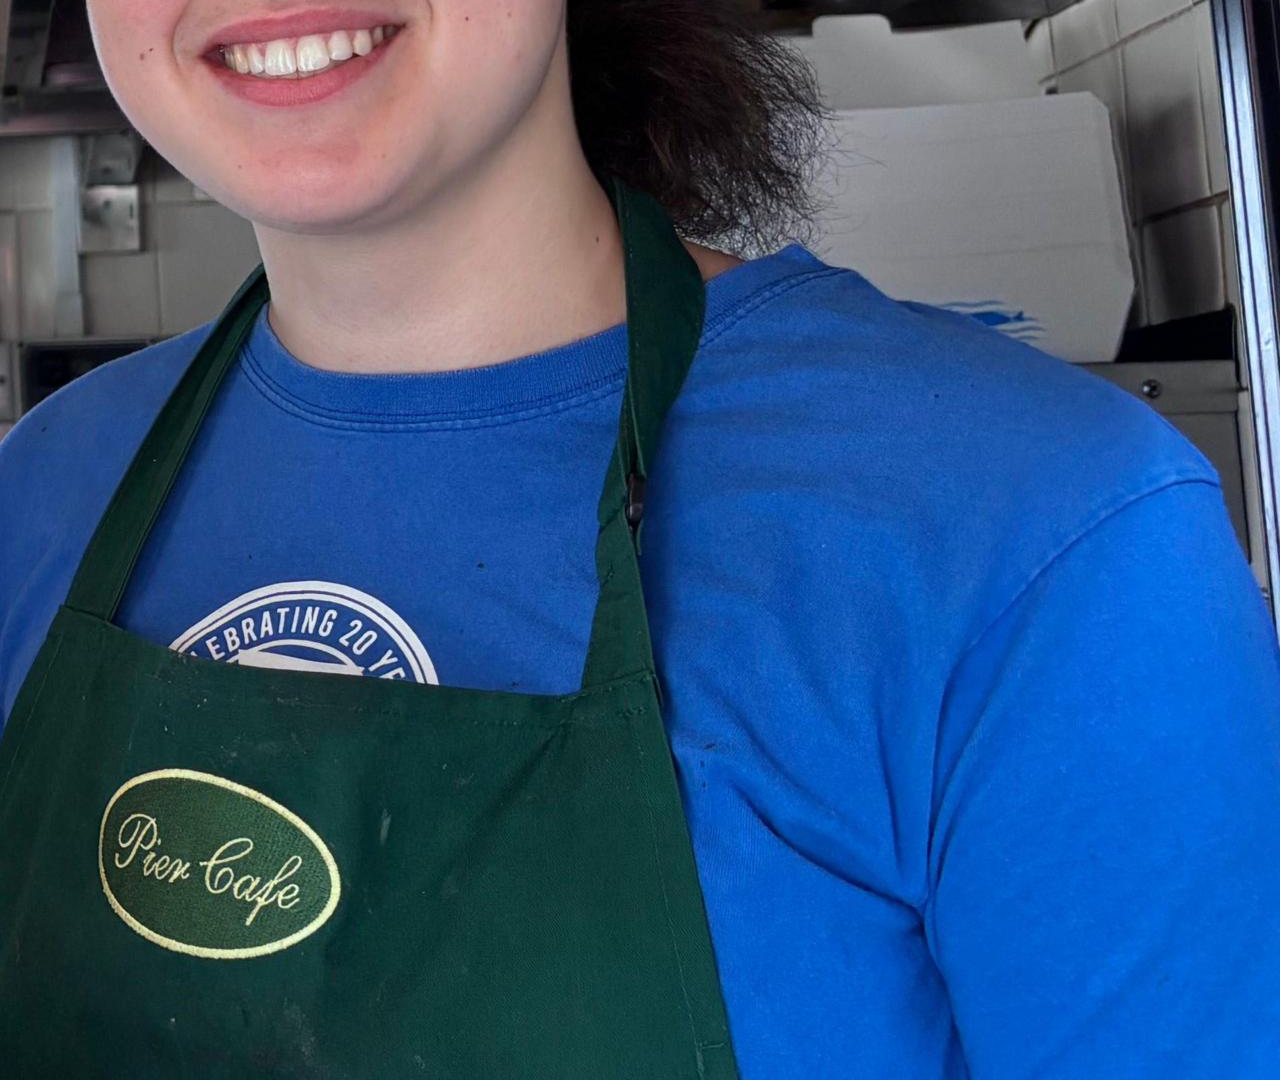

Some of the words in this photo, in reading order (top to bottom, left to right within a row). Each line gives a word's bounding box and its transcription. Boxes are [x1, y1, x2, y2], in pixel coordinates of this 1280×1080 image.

[191, 606, 337, 662] EBRATING
[339, 620, 378, 656] 20
[114, 813, 190, 884] Pier
[199, 837, 302, 926] Cafe
